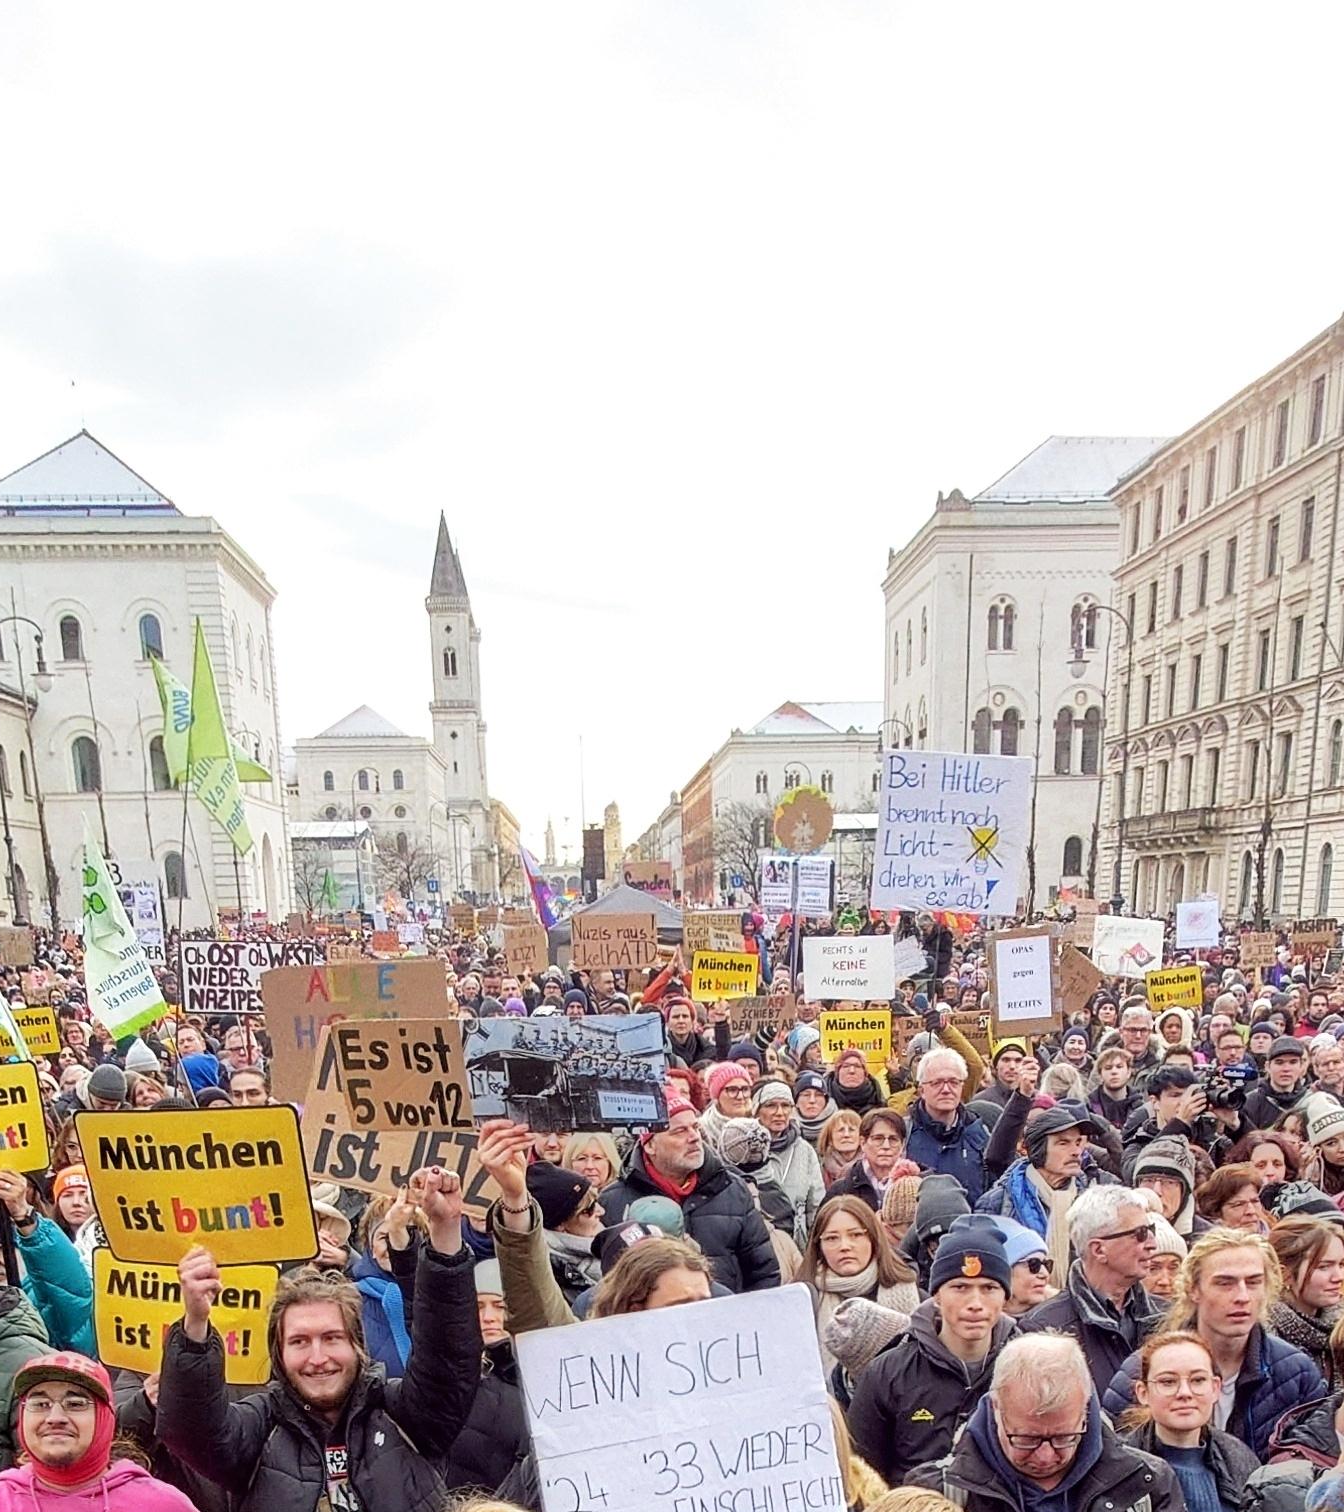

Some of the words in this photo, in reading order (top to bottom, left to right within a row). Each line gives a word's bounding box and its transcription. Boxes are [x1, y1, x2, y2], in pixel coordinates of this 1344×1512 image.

[888, 755, 927, 789] Bei
[941, 758, 1010, 794] Hitler
[887, 795, 946, 824] brennt
[952, 805, 999, 826] noch
[879, 860, 936, 889] drehen
[943, 869, 970, 888] wir
[926, 890, 947, 906] es
[956, 880, 1000, 910] ab!
[572, 919, 611, 941] Nazis
[617, 914, 655, 941] raus!
[207, 943, 246, 967] OST
[822, 945, 854, 955] RECHTS
[1011, 944, 1034, 955] OPAS
[698, 958, 752, 972] München
[832, 959, 867, 971] KEINE
[1012, 968, 1034, 978] gegen
[188, 967, 253, 987] NIEDER
[699, 978, 712, 990] ist
[714, 979, 748, 992] bunt!
[1150, 972, 1197, 987] München
[1007, 998, 1043, 1009] RECHTS
[1154, 990, 1165, 1002] ist
[1167, 988, 1196, 1002] bunt!
[16, 1015, 50, 1028] nchen
[741, 1008, 782, 1019] SCHIEBT
[825, 1018, 885, 1031] München
[338, 1029, 389, 1071] Es
[399, 1026, 452, 1073] ist
[828, 1039, 844, 1051] ist
[848, 1038, 883, 1051] bunt!
[347, 1079, 376, 1124] 5
[98, 1132, 283, 1171] München
[313, 1114, 382, 1183] ist
[116, 1196, 165, 1233] ist
[171, 1193, 284, 1235] bunt!
[107, 1269, 261, 1310] Münen
[114, 1317, 150, 1349] ist
[523, 1352, 641, 1419] WENN
[665, 1331, 762, 1396] SICH
[710, 1422, 828, 1480] WIEDER
[327, 1462, 347, 1475] NZ
